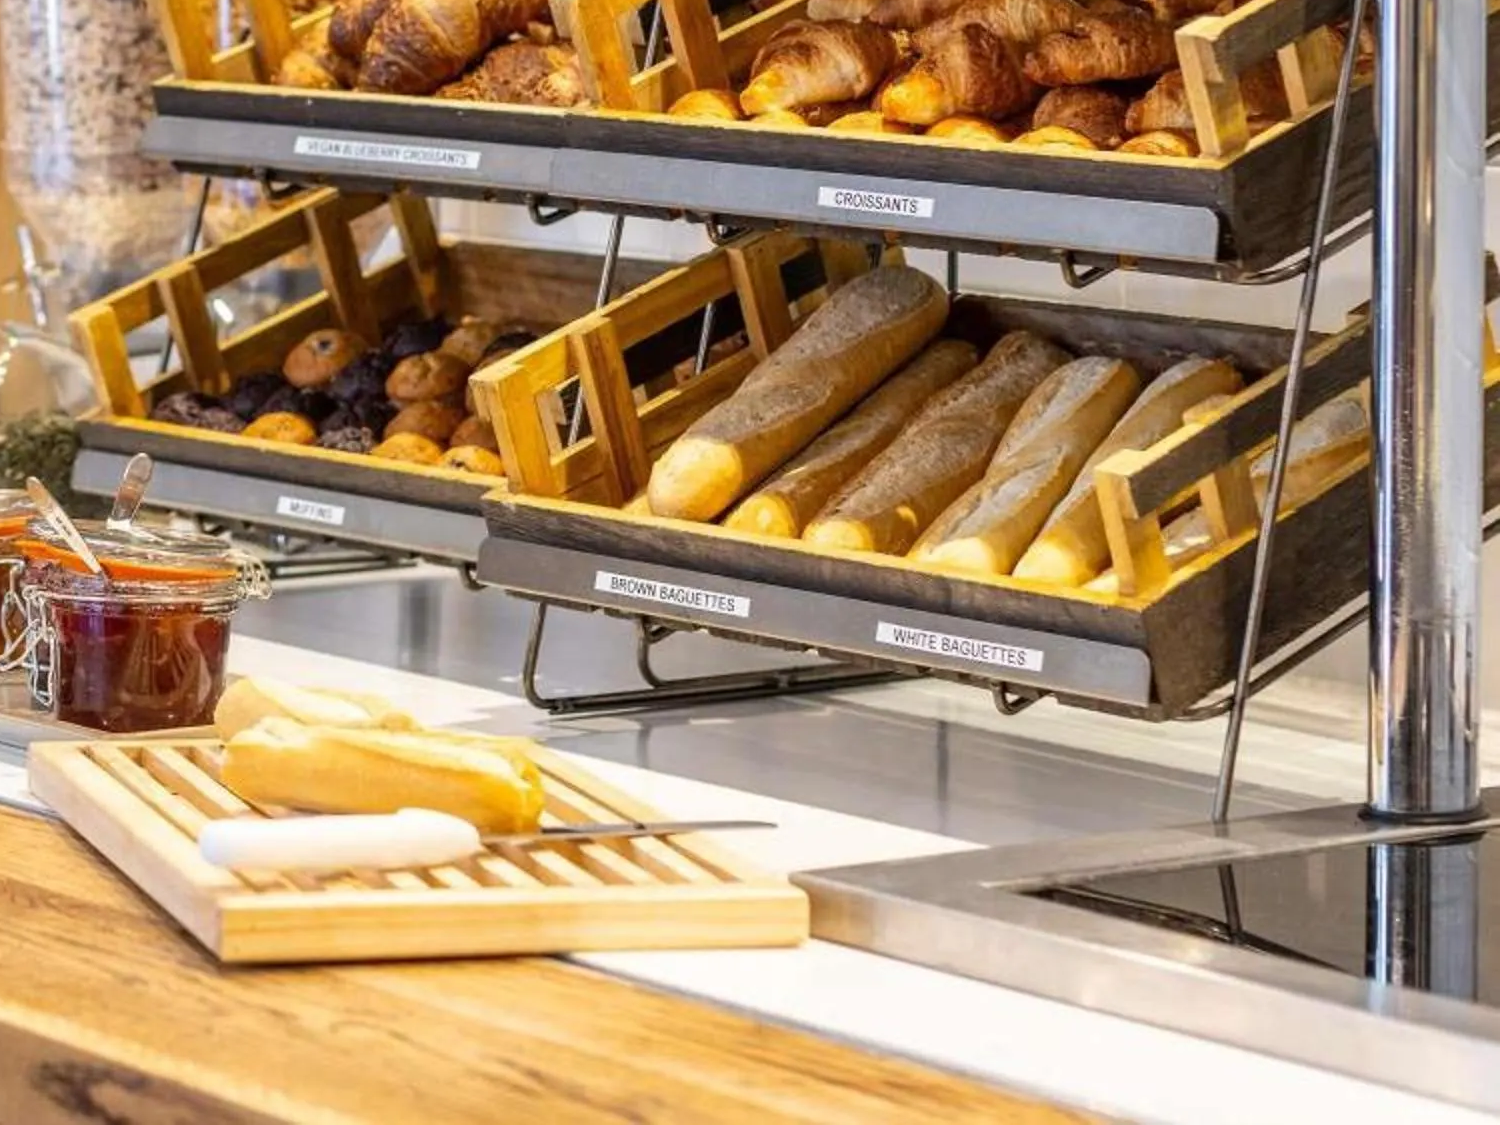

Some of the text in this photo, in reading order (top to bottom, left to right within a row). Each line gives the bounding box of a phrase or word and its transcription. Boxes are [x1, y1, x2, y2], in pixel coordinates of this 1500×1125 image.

[307, 139, 341, 155] VEGAN
[402, 147, 468, 165] CROISSANTS
[835, 190, 918, 214] CROISSANTS
[610, 576, 736, 612] BROWN BAGUETTES
[893, 626, 1027, 666] WHITE BAGUETTES
